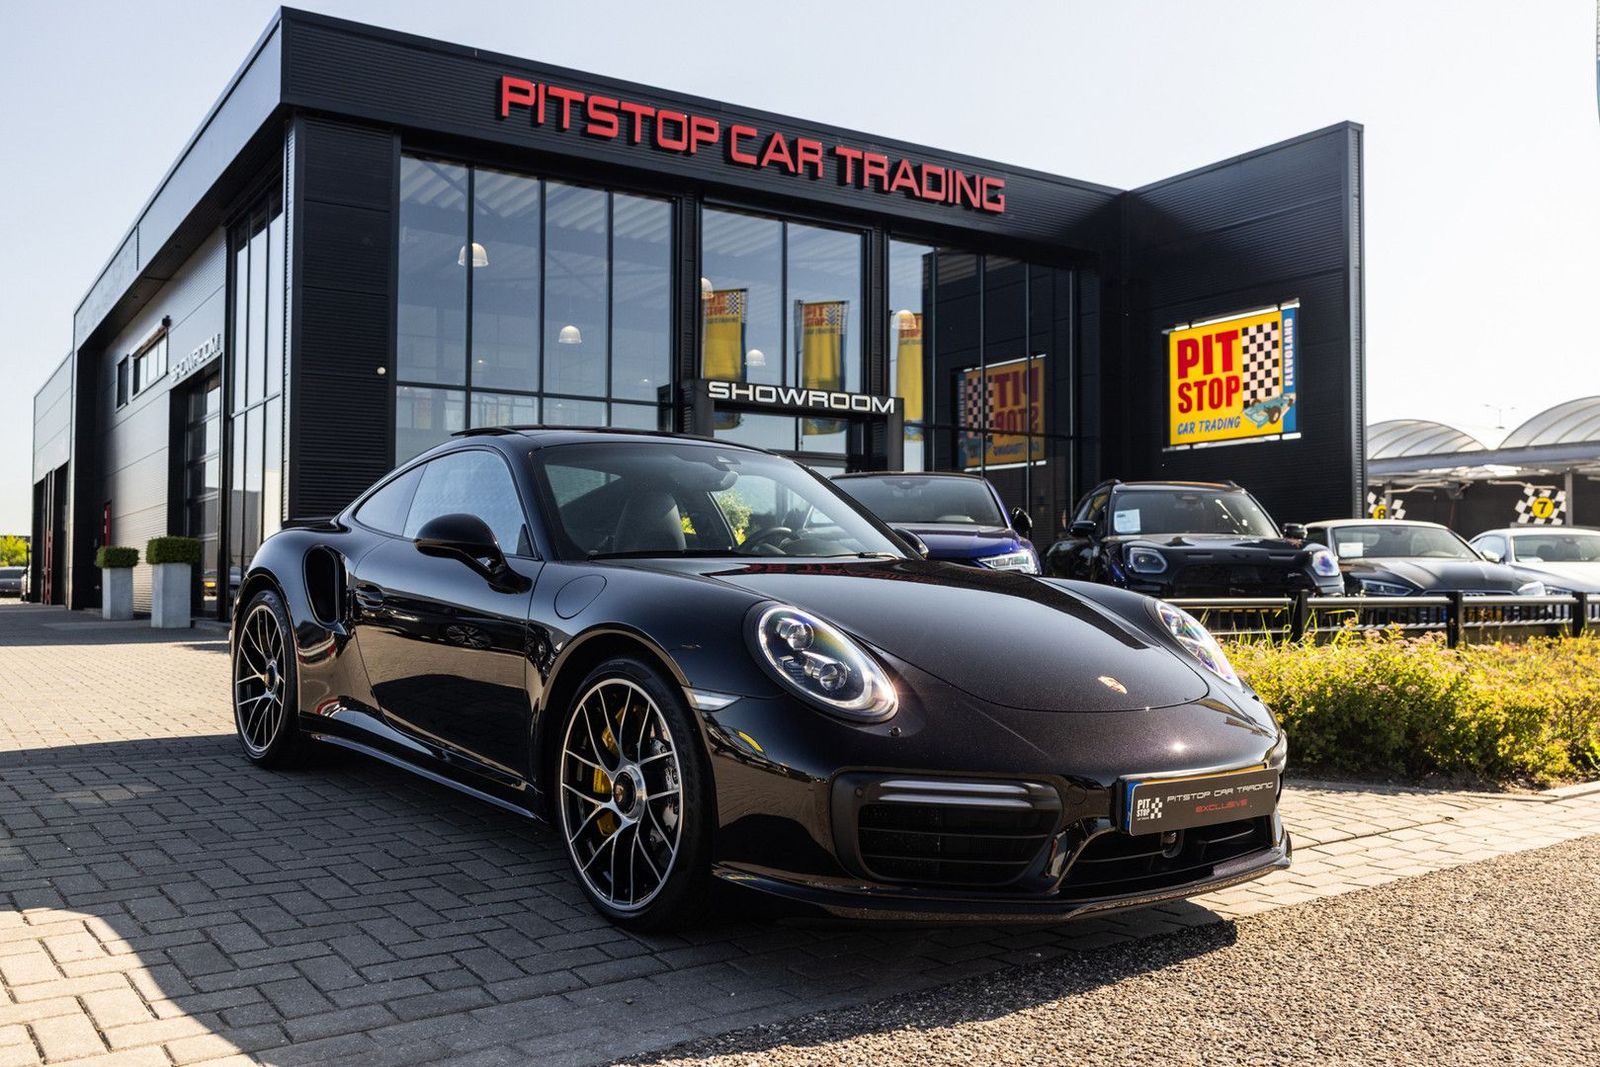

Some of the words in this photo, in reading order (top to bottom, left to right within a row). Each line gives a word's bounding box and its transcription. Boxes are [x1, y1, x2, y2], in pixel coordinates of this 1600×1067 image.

[501, 75, 719, 154] PITSTOP
[730, 124, 823, 179] CAR
[834, 145, 1006, 213] TRADING
[1177, 329, 1239, 380] PIT
[1284, 318, 1294, 386] FLEVOLAND
[708, 381, 895, 414] SHOWROOM
[1178, 375, 1240, 414] STOP
[1177, 421, 1195, 435] CAR
[1199, 415, 1241, 432] TRADING
[1537, 501, 1548, 514] 7
[1167, 791, 1211, 802] PITSTOP
[1214, 788, 1234, 797] CAR
[1237, 781, 1273, 793] TRADING
[1137, 798, 1151, 810] PIT
[1137, 808, 1150, 818] STOP
[1195, 799, 1248, 813] EXCLUSIVE
